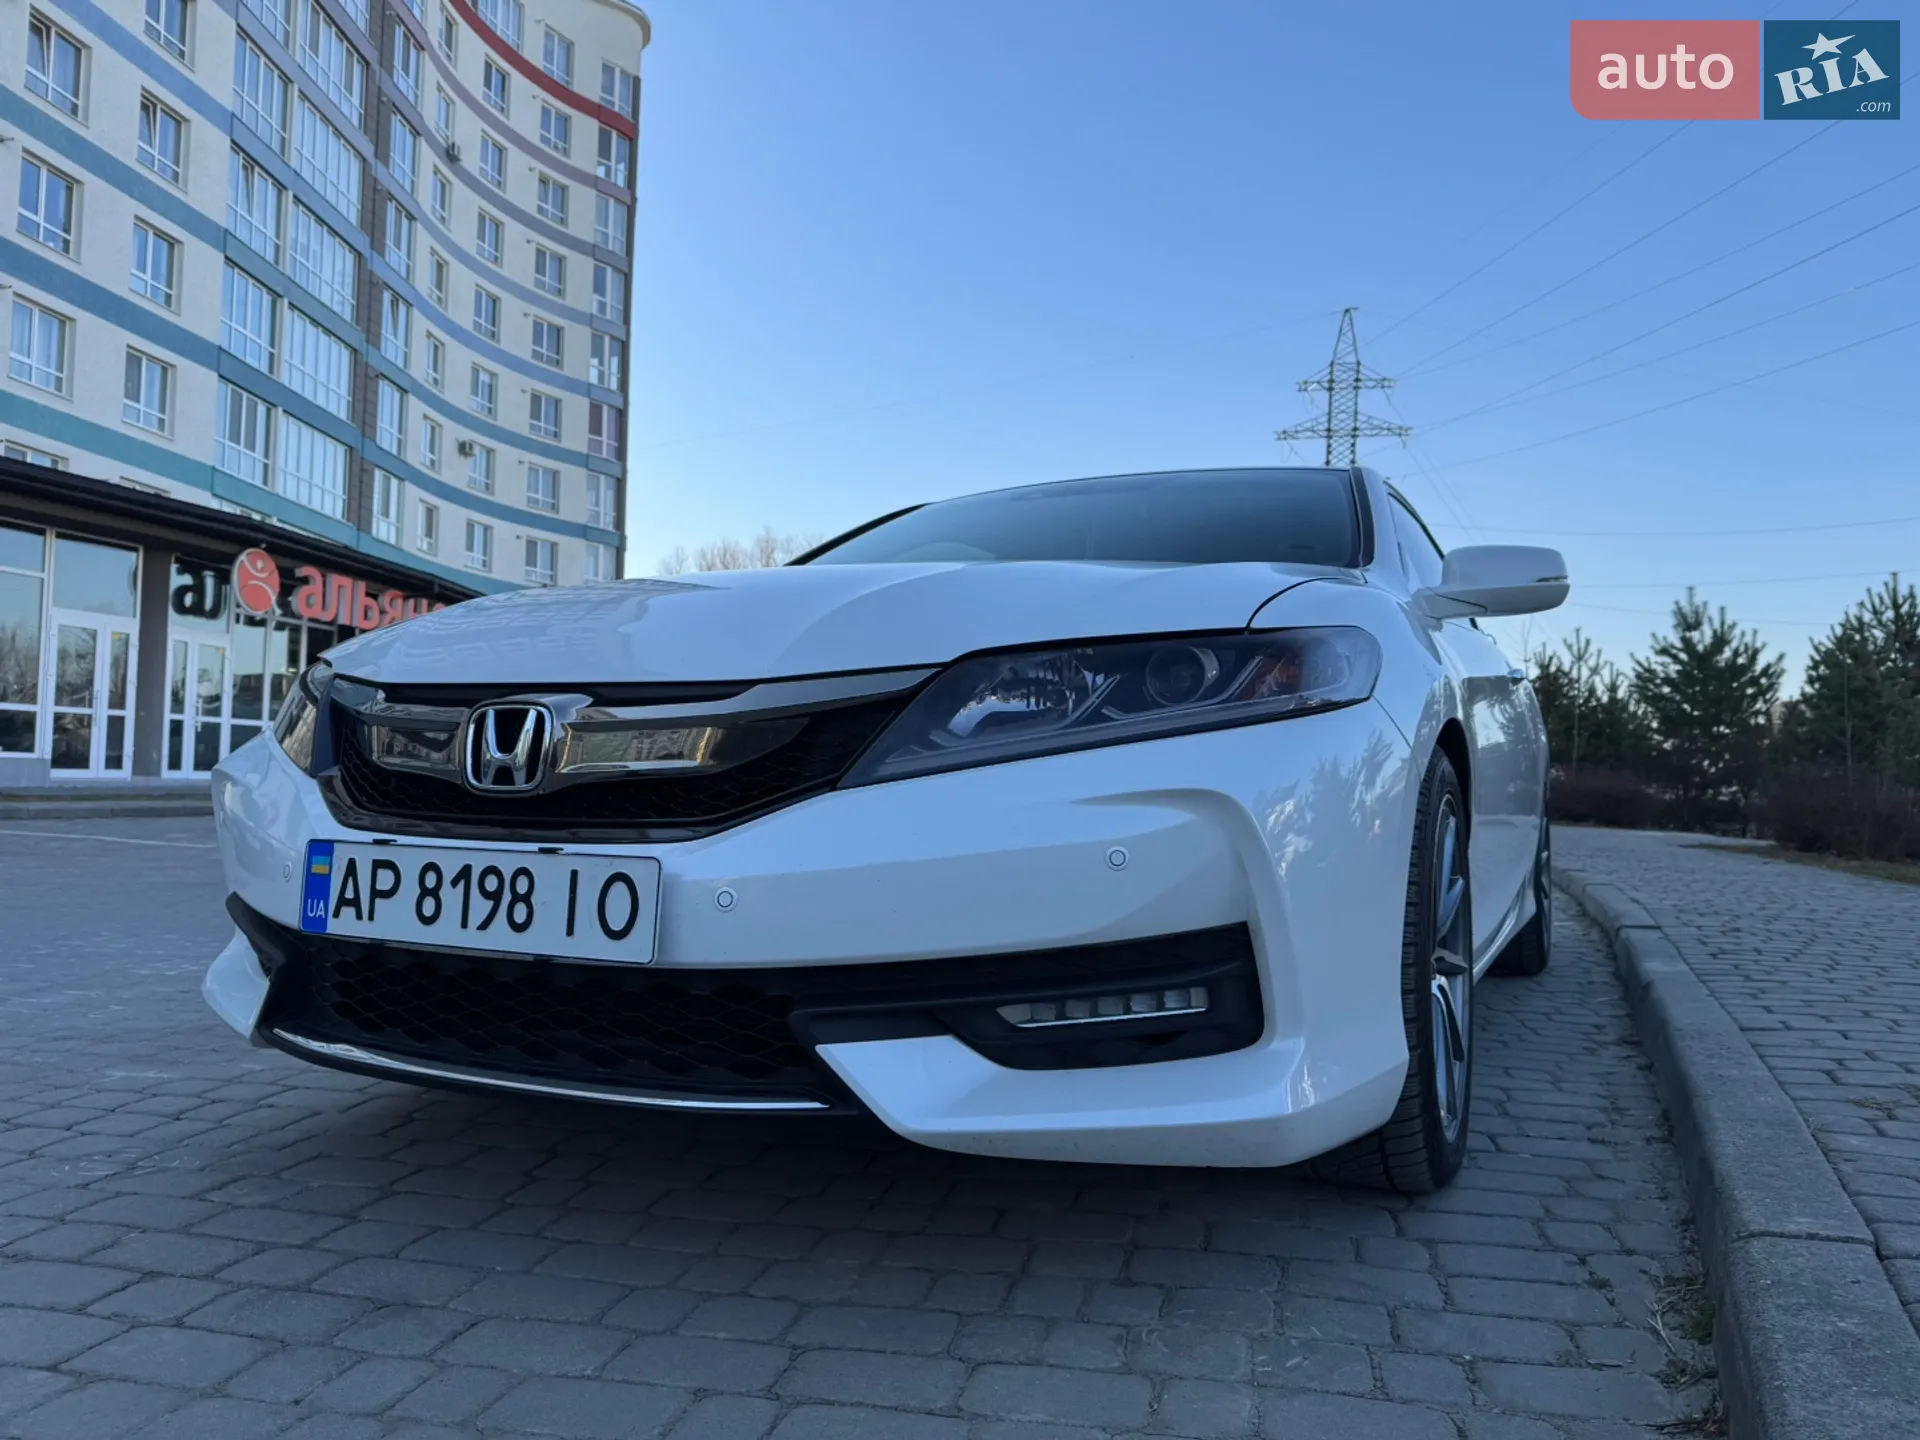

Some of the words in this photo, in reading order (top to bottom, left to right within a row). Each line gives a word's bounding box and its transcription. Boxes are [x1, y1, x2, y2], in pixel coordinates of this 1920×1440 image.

[306, 898, 326, 919] UA
[332, 857, 402, 922] AP
[415, 861, 535, 934] 8198
